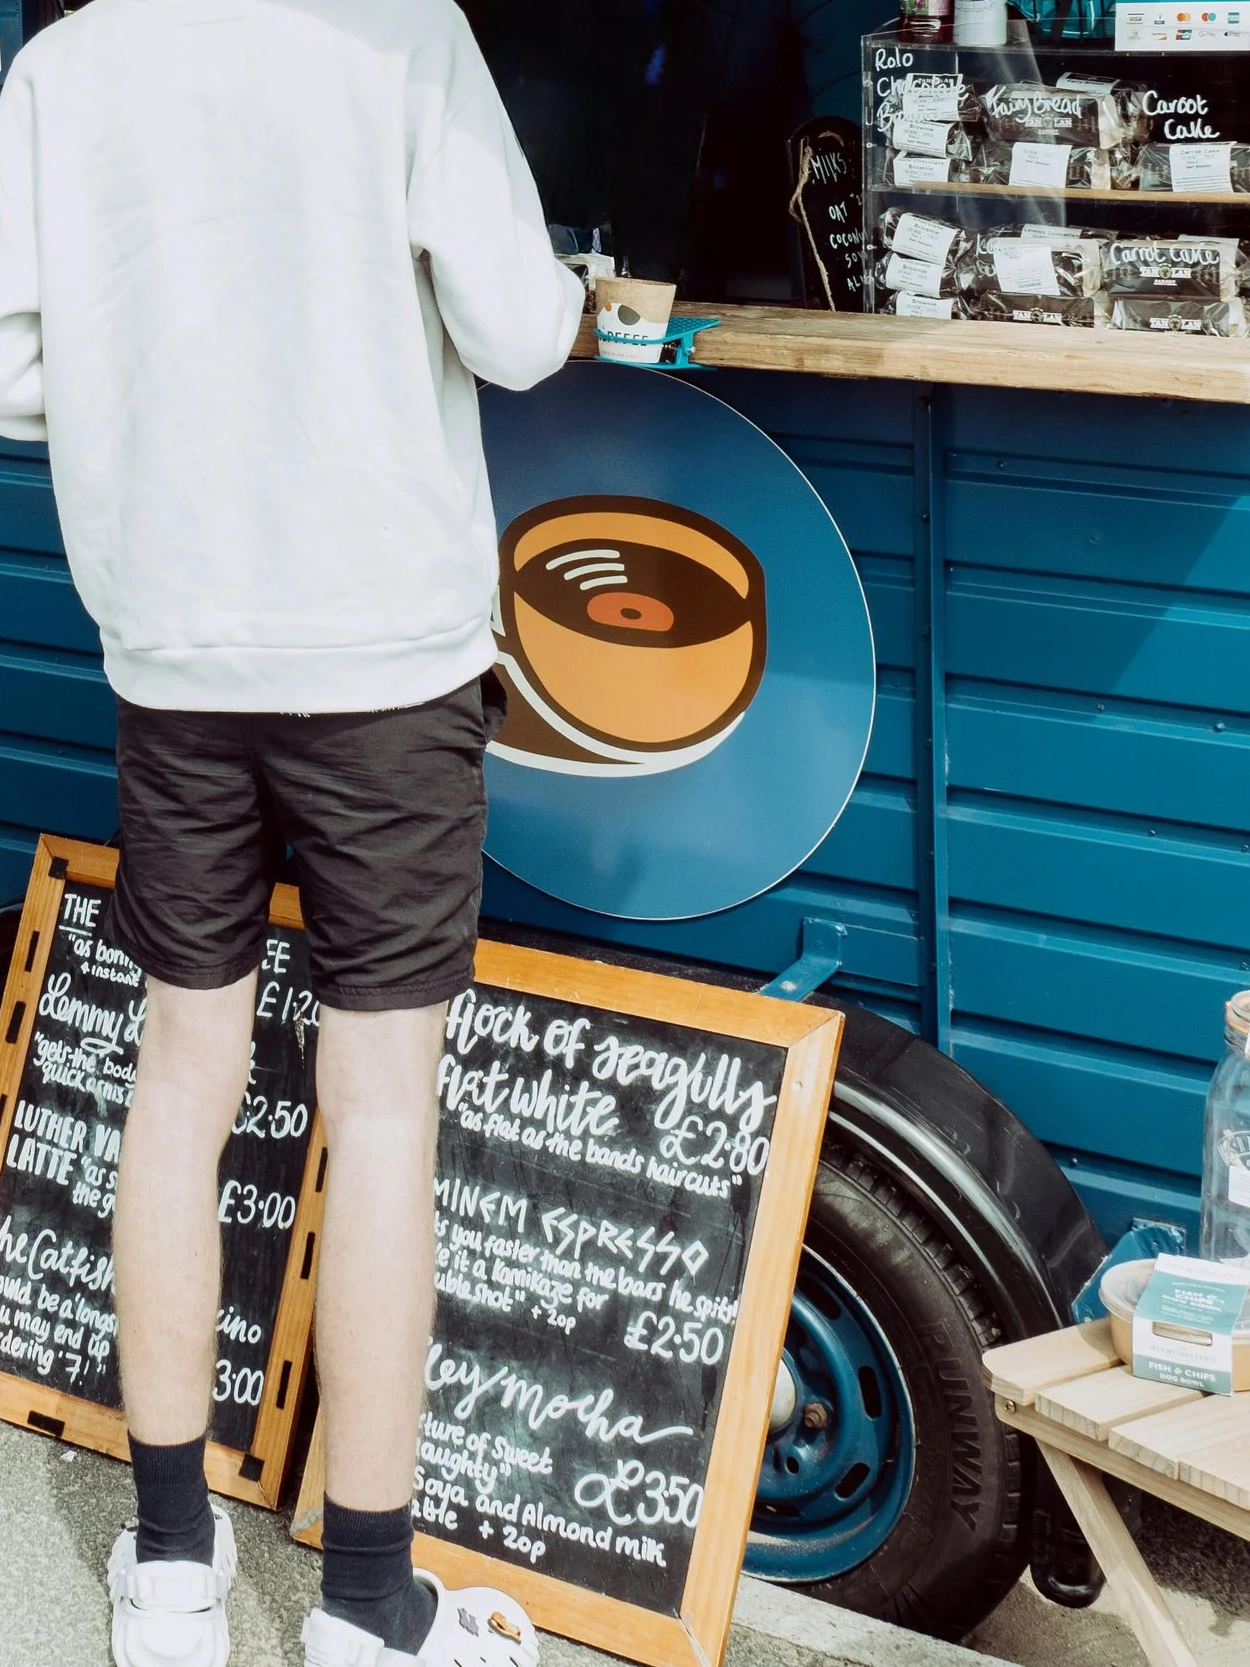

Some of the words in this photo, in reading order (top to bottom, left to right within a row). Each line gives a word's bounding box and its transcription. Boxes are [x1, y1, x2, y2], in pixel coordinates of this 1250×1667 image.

[875, 47, 914, 72] Rolo
[1164, 118, 1220, 140] Cake
[828, 201, 846, 223] OAT
[1110, 242, 1166, 265] Carrot
[1169, 242, 1219, 265] Cake
[63, 892, 102, 928] THE
[38, 972, 124, 1055] Lemmy
[41, 1060, 86, 1092] quick
[436, 1054, 510, 1113] flat
[592, 1036, 777, 1133] seagulls
[14, 1099, 88, 1154] LUTHER
[483, 1113, 521, 1141] flat
[521, 1127, 547, 1150] as
[545, 1132, 583, 1162] the
[585, 1138, 645, 1174] bands
[6, 1133, 78, 1186] LATTE
[72, 1181, 102, 1208] the
[433, 1177, 528, 1233] MINEM
[541, 1207, 710, 1278] ESPRESSO
[449, 1223, 483, 1252] you
[483, 1234, 541, 1263] faster
[540, 1249, 582, 1280] than
[584, 1261, 617, 1290] the
[617, 1266, 666, 1302] bars
[668, 1279, 694, 1314] he
[453, 1249, 471, 1272] it
[472, 1259, 488, 1280] a
[577, 1286, 610, 1313] for
[37, 1283, 61, 1313] be
[58, 1299, 74, 1320] a
[13, 1309, 51, 1344] may
[53, 1324, 85, 1350] end
[87, 1332, 110, 1367] up
[1148, 1361, 1171, 1373] FISH
[1184, 1368, 1216, 1382] CHIPS
[1159, 1373, 1179, 1382] DOG
[1180, 1377, 1205, 1388] BOWL
[465, 1432, 492, 1469] of
[916, 1318, 983, 1532] RUNWAY
[474, 1494, 521, 1523] and
[521, 1503, 613, 1549] Almond
[614, 1535, 667, 1568] milk
